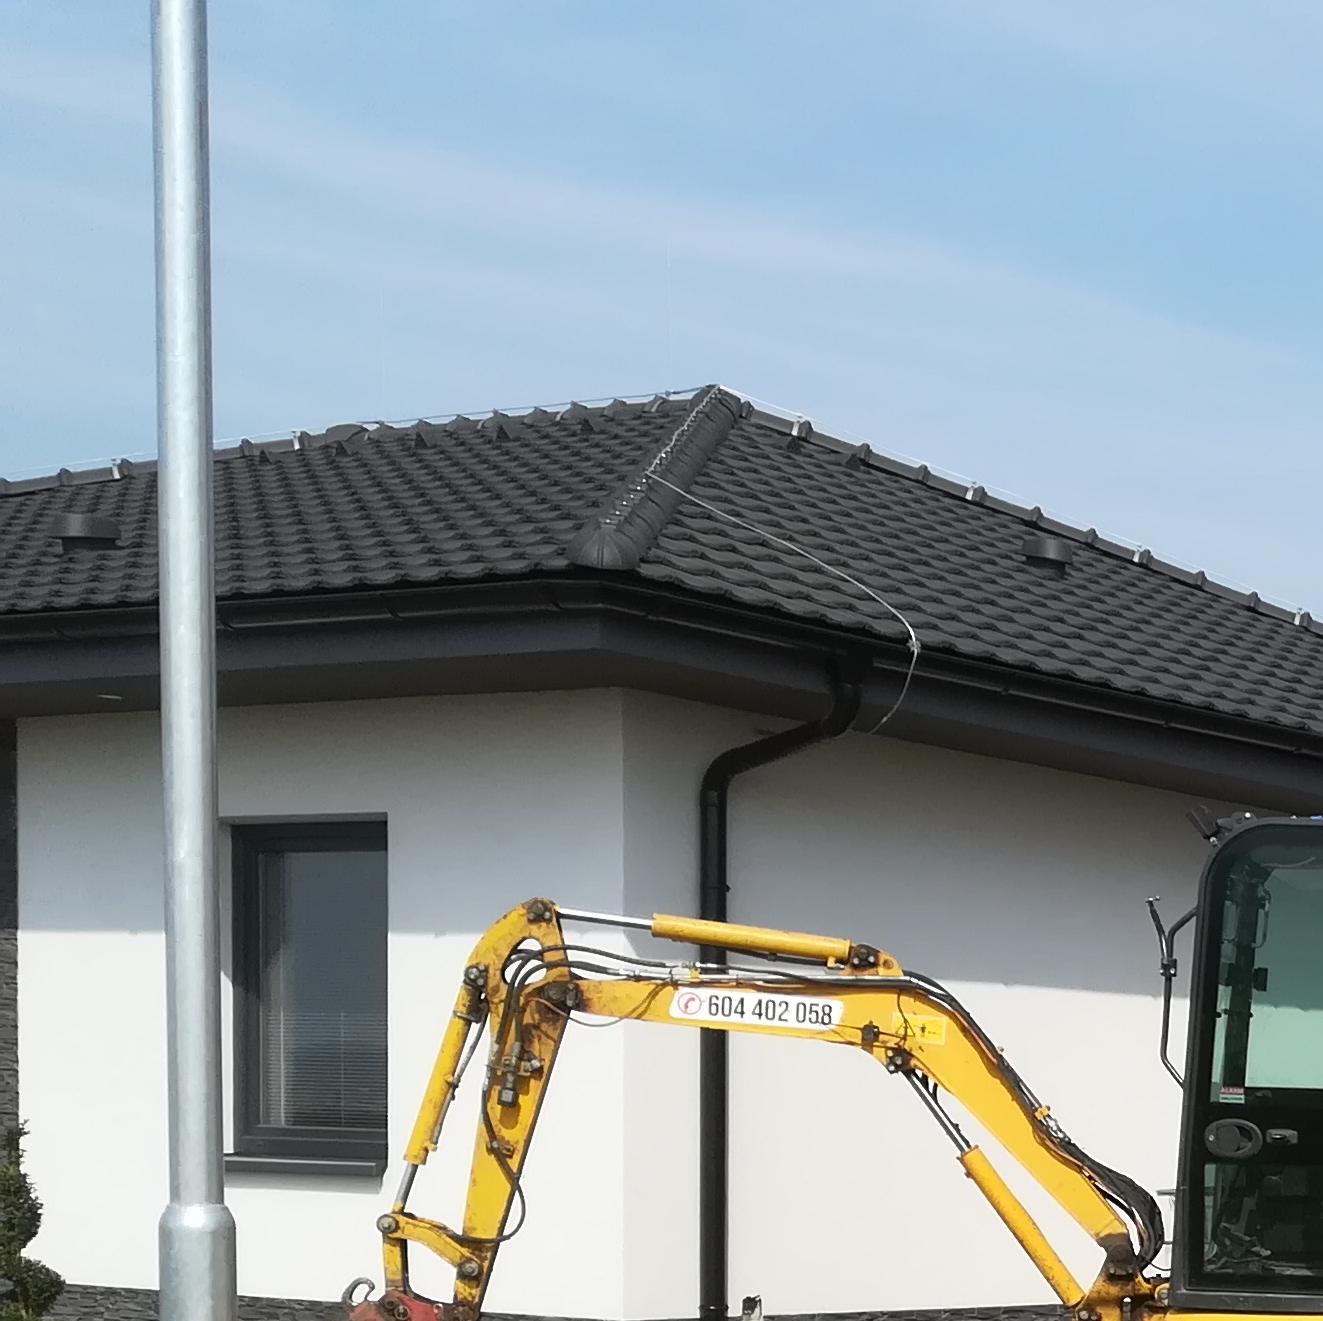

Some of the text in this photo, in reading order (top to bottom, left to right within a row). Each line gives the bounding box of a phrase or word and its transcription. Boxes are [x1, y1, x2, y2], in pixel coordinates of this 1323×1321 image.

[708, 994, 833, 1026] 604 402 058
